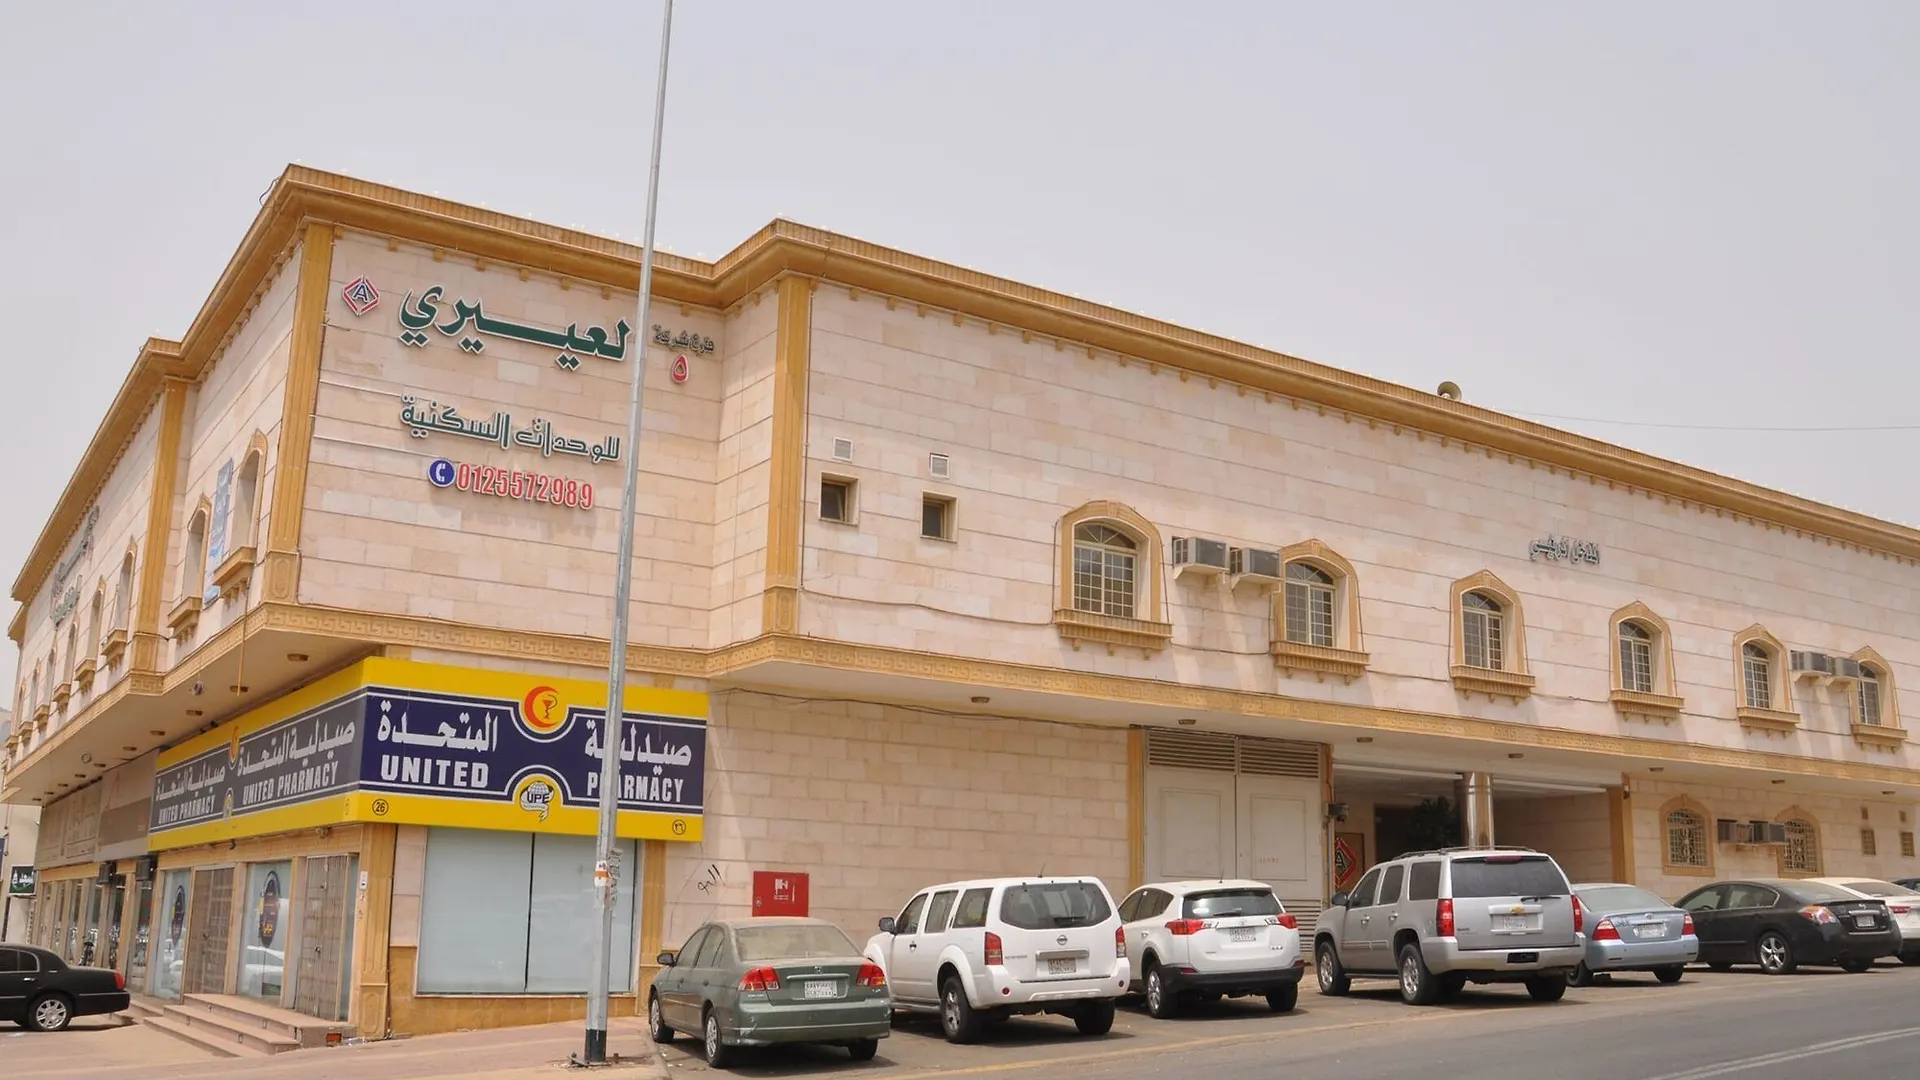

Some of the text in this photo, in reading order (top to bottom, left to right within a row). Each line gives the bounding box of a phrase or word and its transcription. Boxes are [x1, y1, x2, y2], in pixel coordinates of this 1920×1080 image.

[398, 284, 632, 371] لعييري
[400, 395, 620, 464] للوحدات السكنية
[456, 463, 594, 509] 0125572989
[237, 718, 356, 777] صيدلية المتحدة
[377, 700, 498, 752] المتحدة
[242, 760, 339, 805] UNITED PHARMACY
[380, 754, 684, 803] UNITED PRMACY
[158, 794, 216, 824] UNITED PHARMACY
[375, 802, 386, 813] 26
